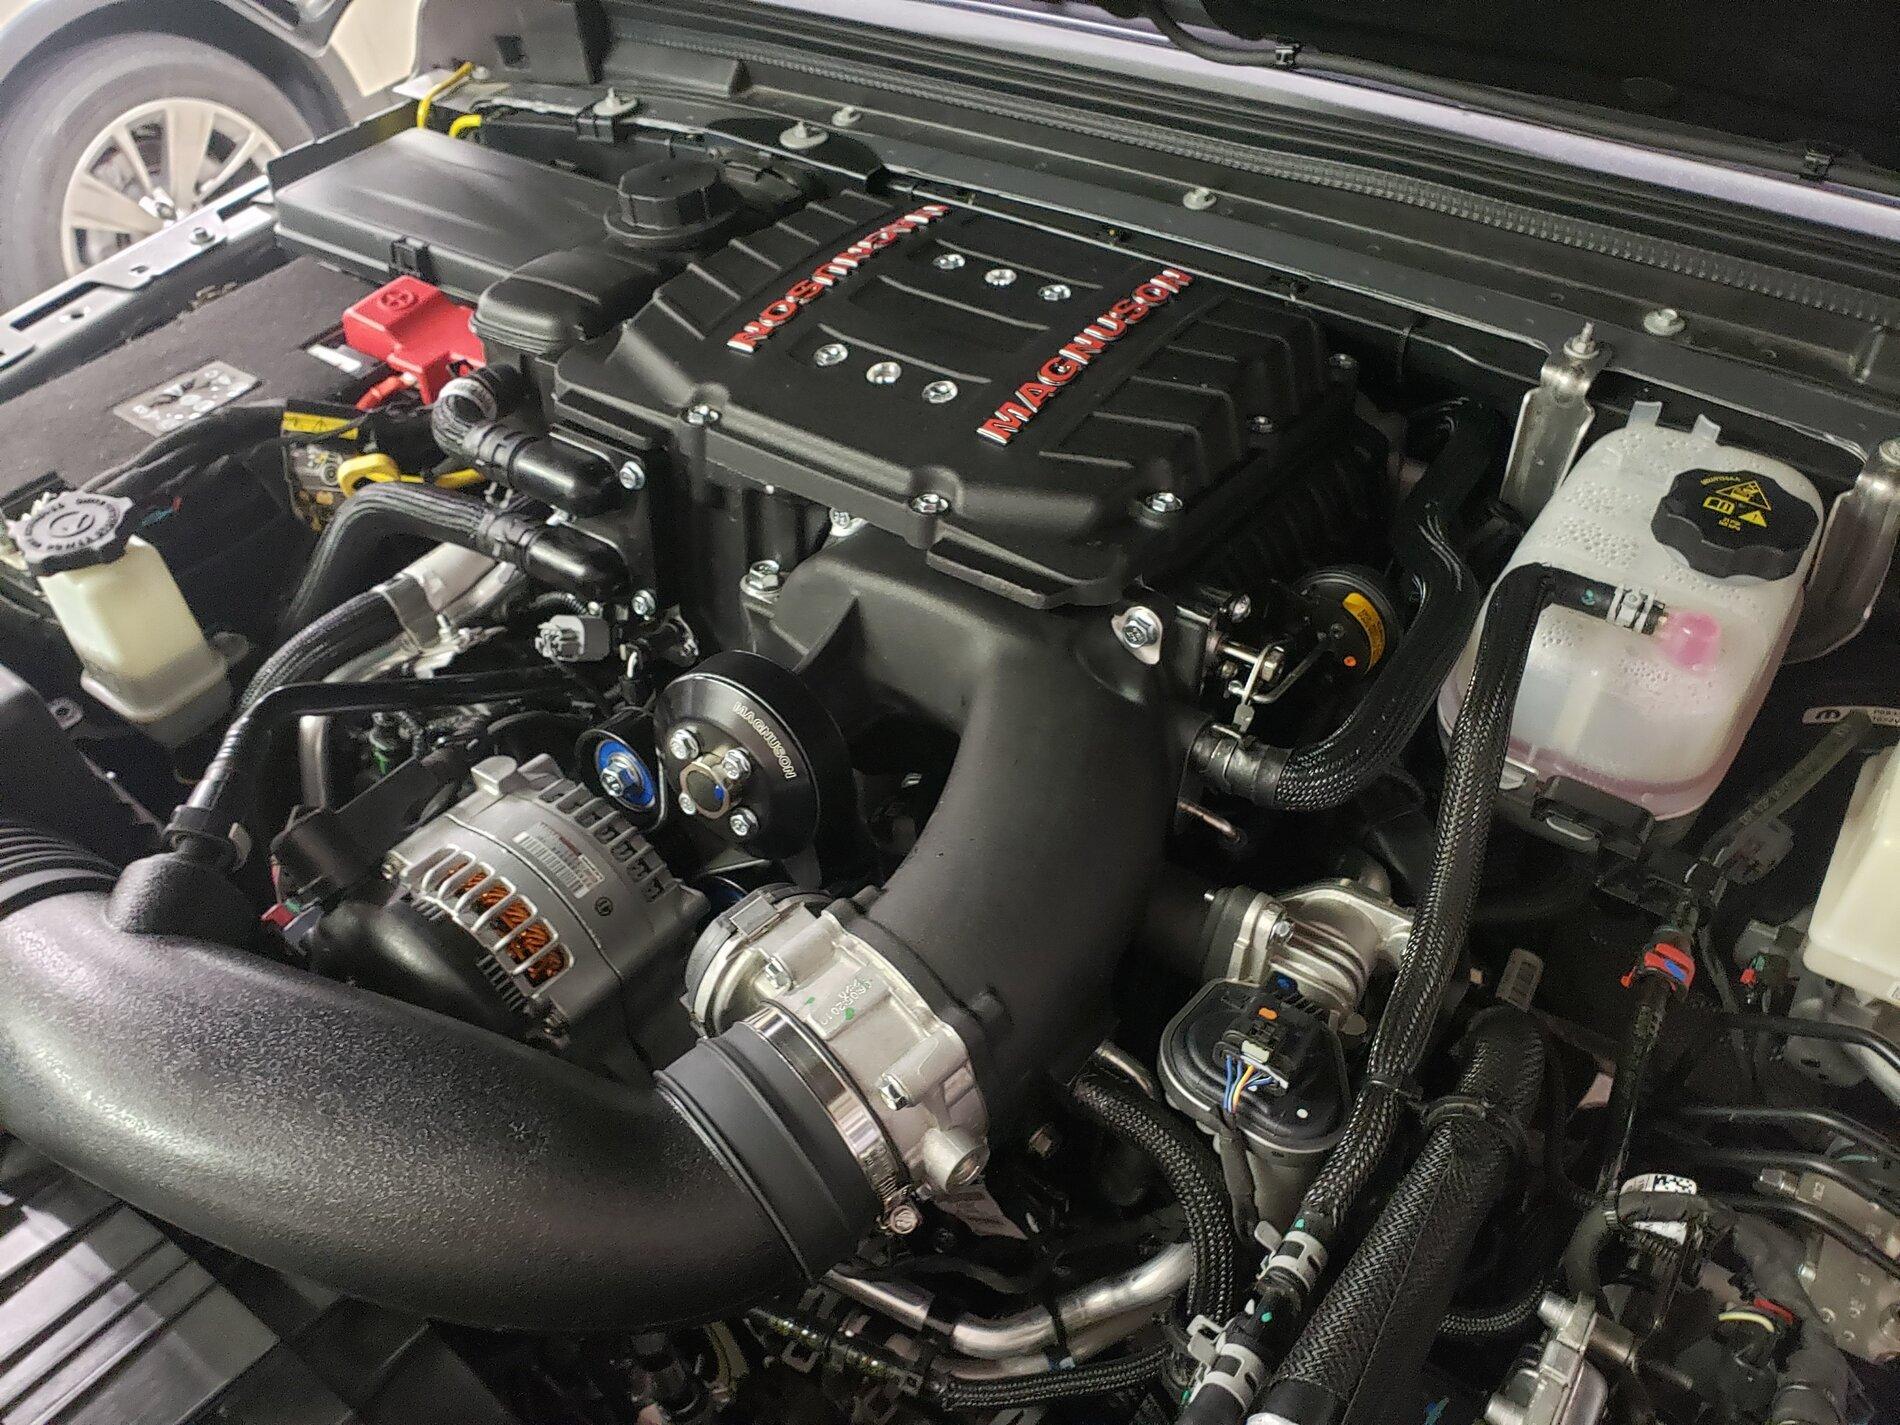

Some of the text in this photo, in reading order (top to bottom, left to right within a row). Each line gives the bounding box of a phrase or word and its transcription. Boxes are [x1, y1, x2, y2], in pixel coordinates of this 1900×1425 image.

[727, 204, 950, 354] MAGNUSON
[976, 267, 1193, 445] MAGNUSON
[732, 701, 797, 779] MAGNUSON
